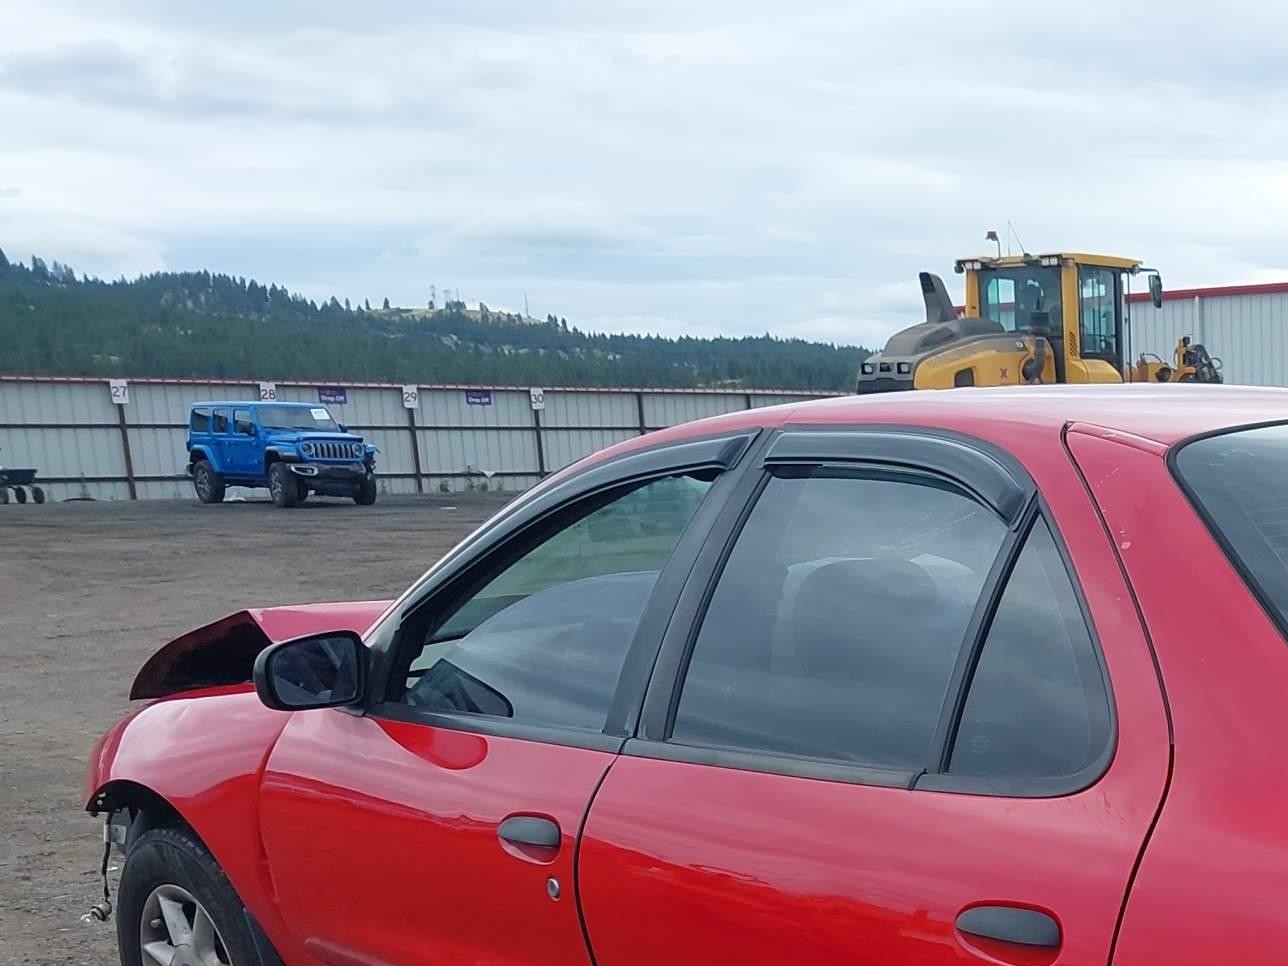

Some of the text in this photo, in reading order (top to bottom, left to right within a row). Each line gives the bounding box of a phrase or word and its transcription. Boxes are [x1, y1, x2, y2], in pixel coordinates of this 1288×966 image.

[112, 386, 127, 398] 27
[261, 389, 276, 400] 28
[404, 392, 417, 402] 29
[531, 394, 544, 404] 30
